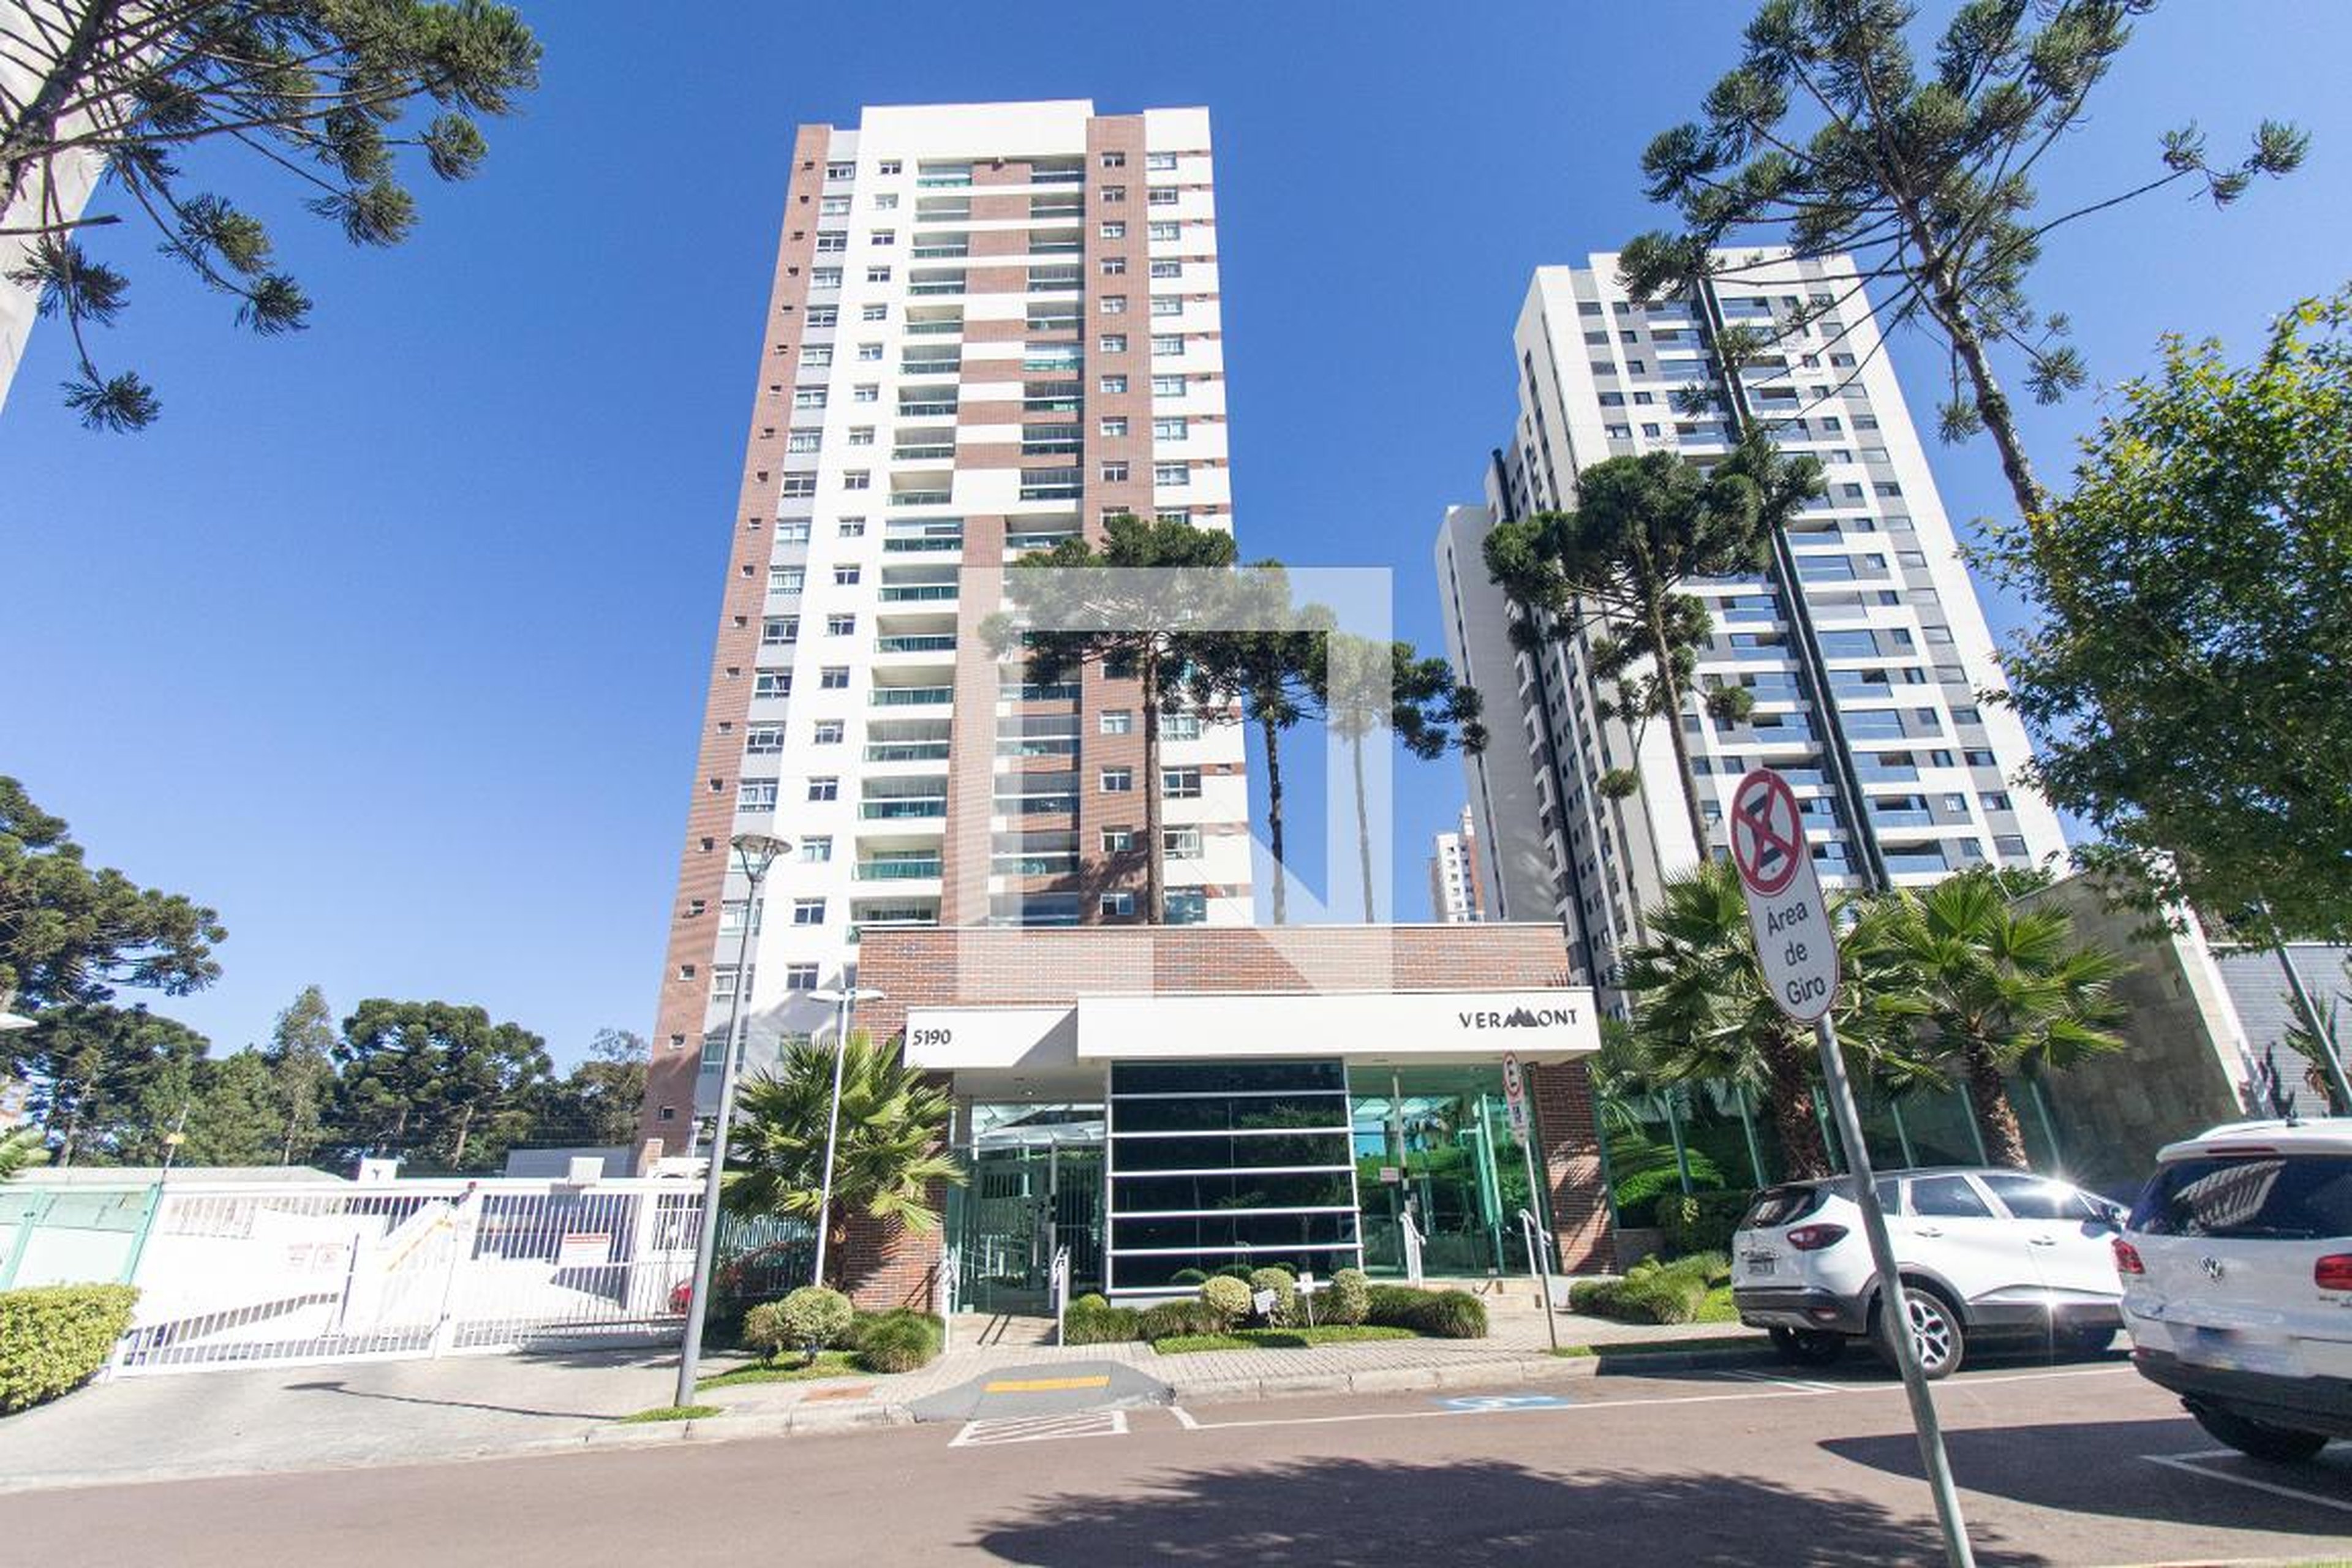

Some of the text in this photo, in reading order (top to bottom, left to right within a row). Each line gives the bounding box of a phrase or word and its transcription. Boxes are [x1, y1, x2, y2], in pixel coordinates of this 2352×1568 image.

[1785, 939, 1807, 967] de
[1786, 976, 1826, 1005] Giro
[1458, 1006, 1577, 1028] VERMONT
[913, 1028, 951, 1046] 5190
